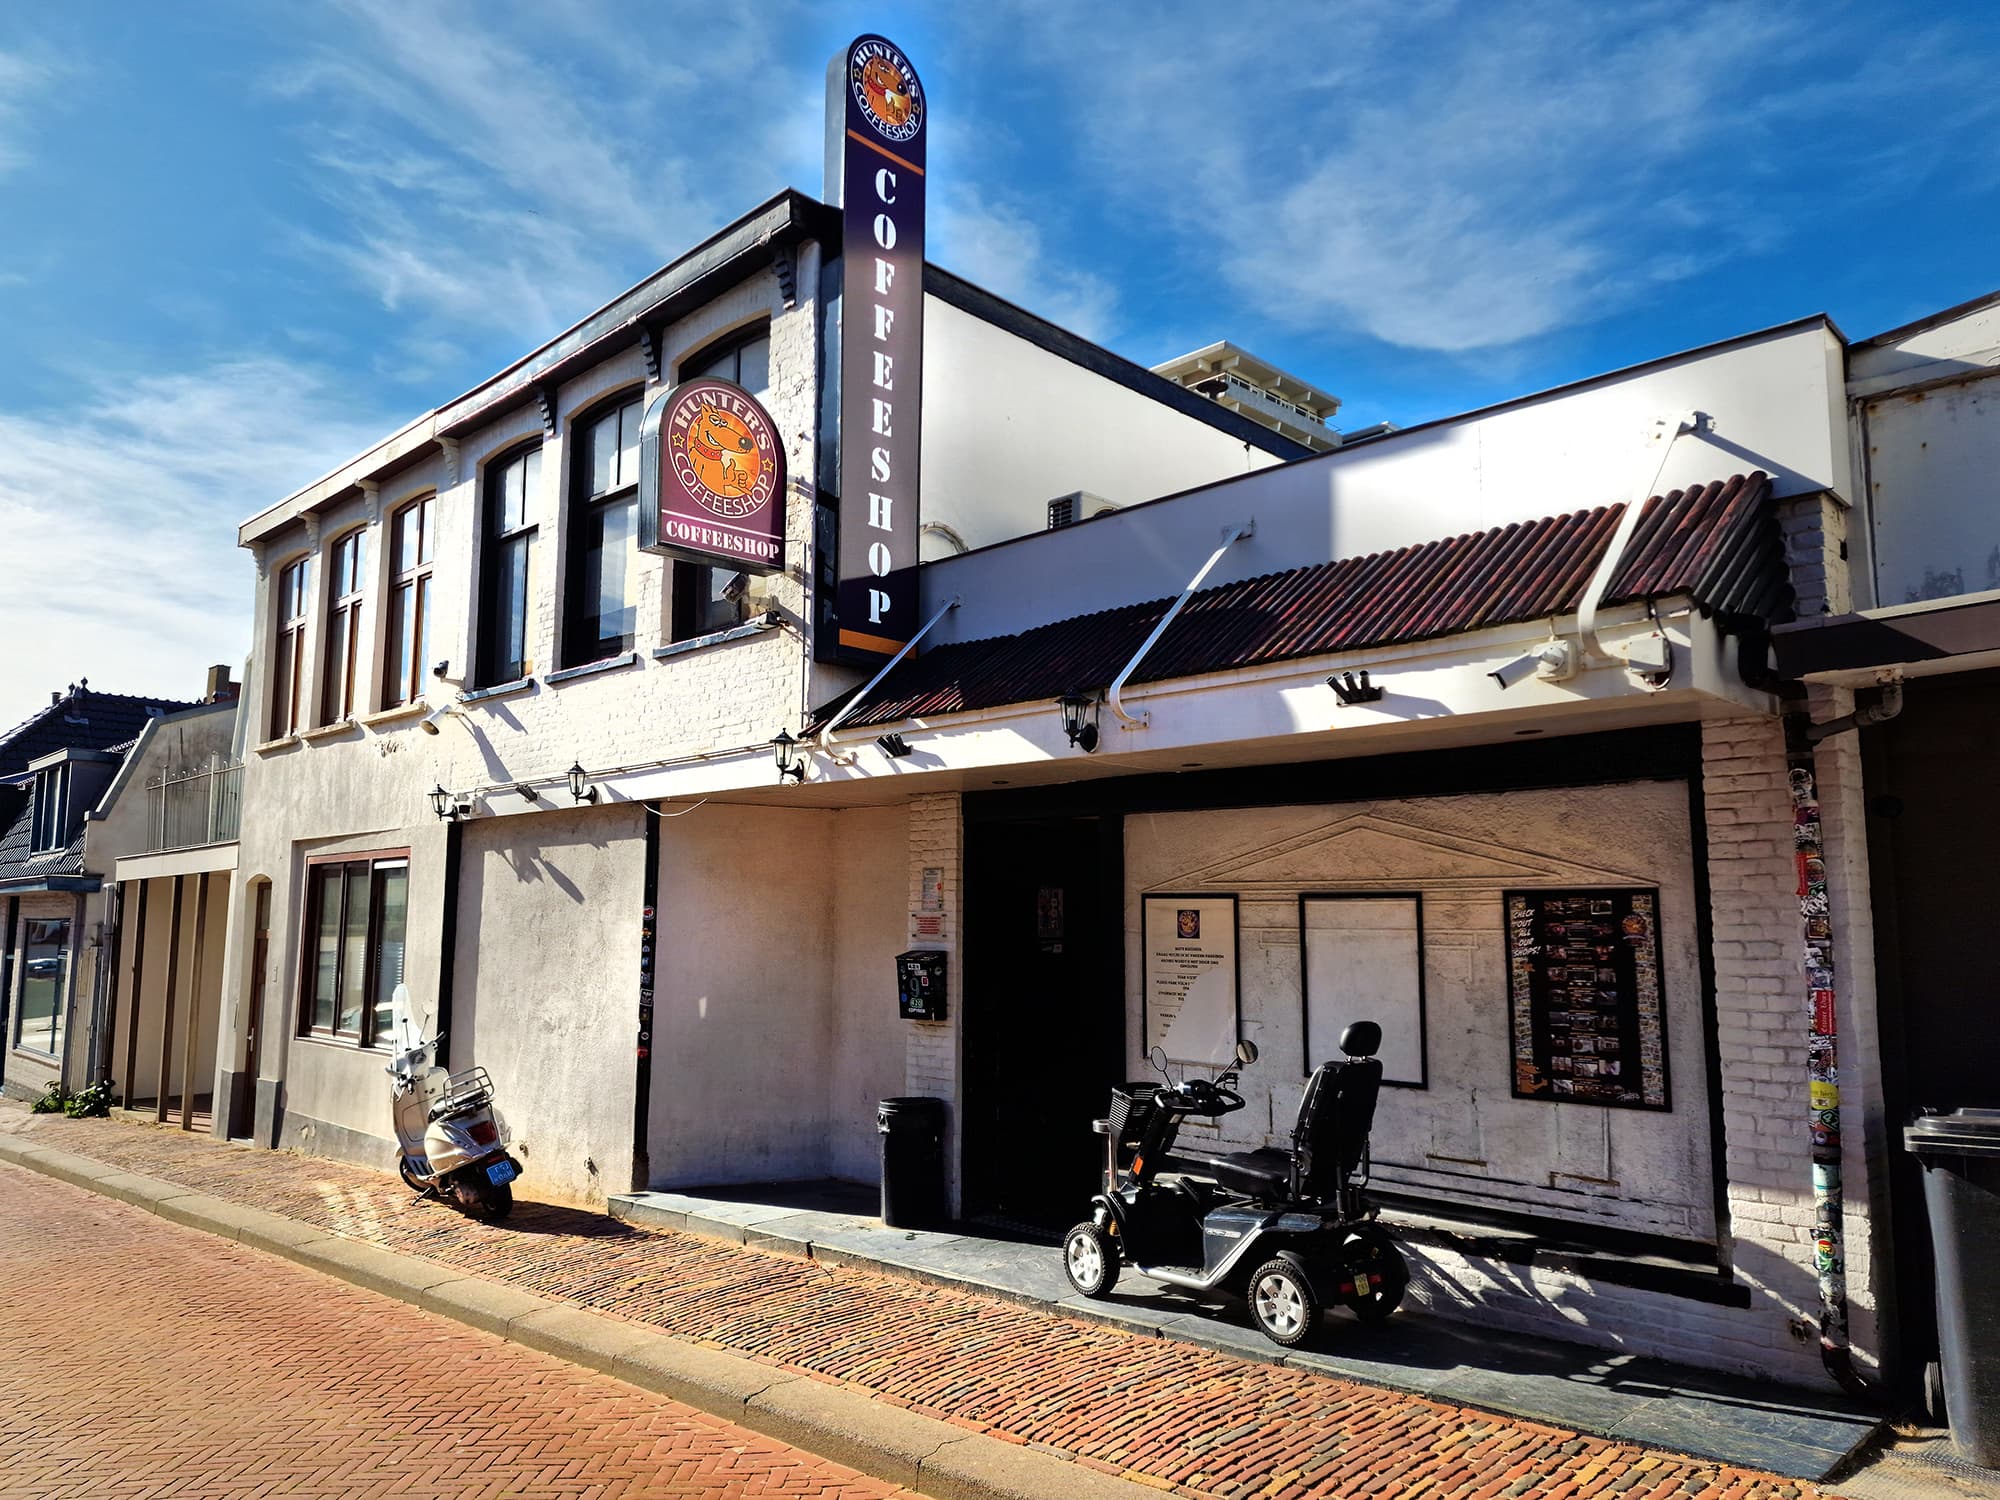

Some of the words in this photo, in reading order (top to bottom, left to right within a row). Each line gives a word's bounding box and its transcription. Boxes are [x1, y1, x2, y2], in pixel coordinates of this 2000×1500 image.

[855, 44, 918, 98] HUNTER'S
[854, 81, 919, 139] COFFEESHOP
[868, 167, 898, 625] COFFEESHOP
[674, 392, 771, 451] HUNTER'S
[674, 451, 772, 517] COFFEESHOP
[665, 520, 780, 559] COFFEESHOP
[1513, 909, 1536, 919] CHECK
[1516, 918, 1533, 928] OUT
[1518, 928, 1532, 938] ALL
[1513, 946, 1542, 957] SHOPS!
[1518, 937, 1534, 947] OUR
